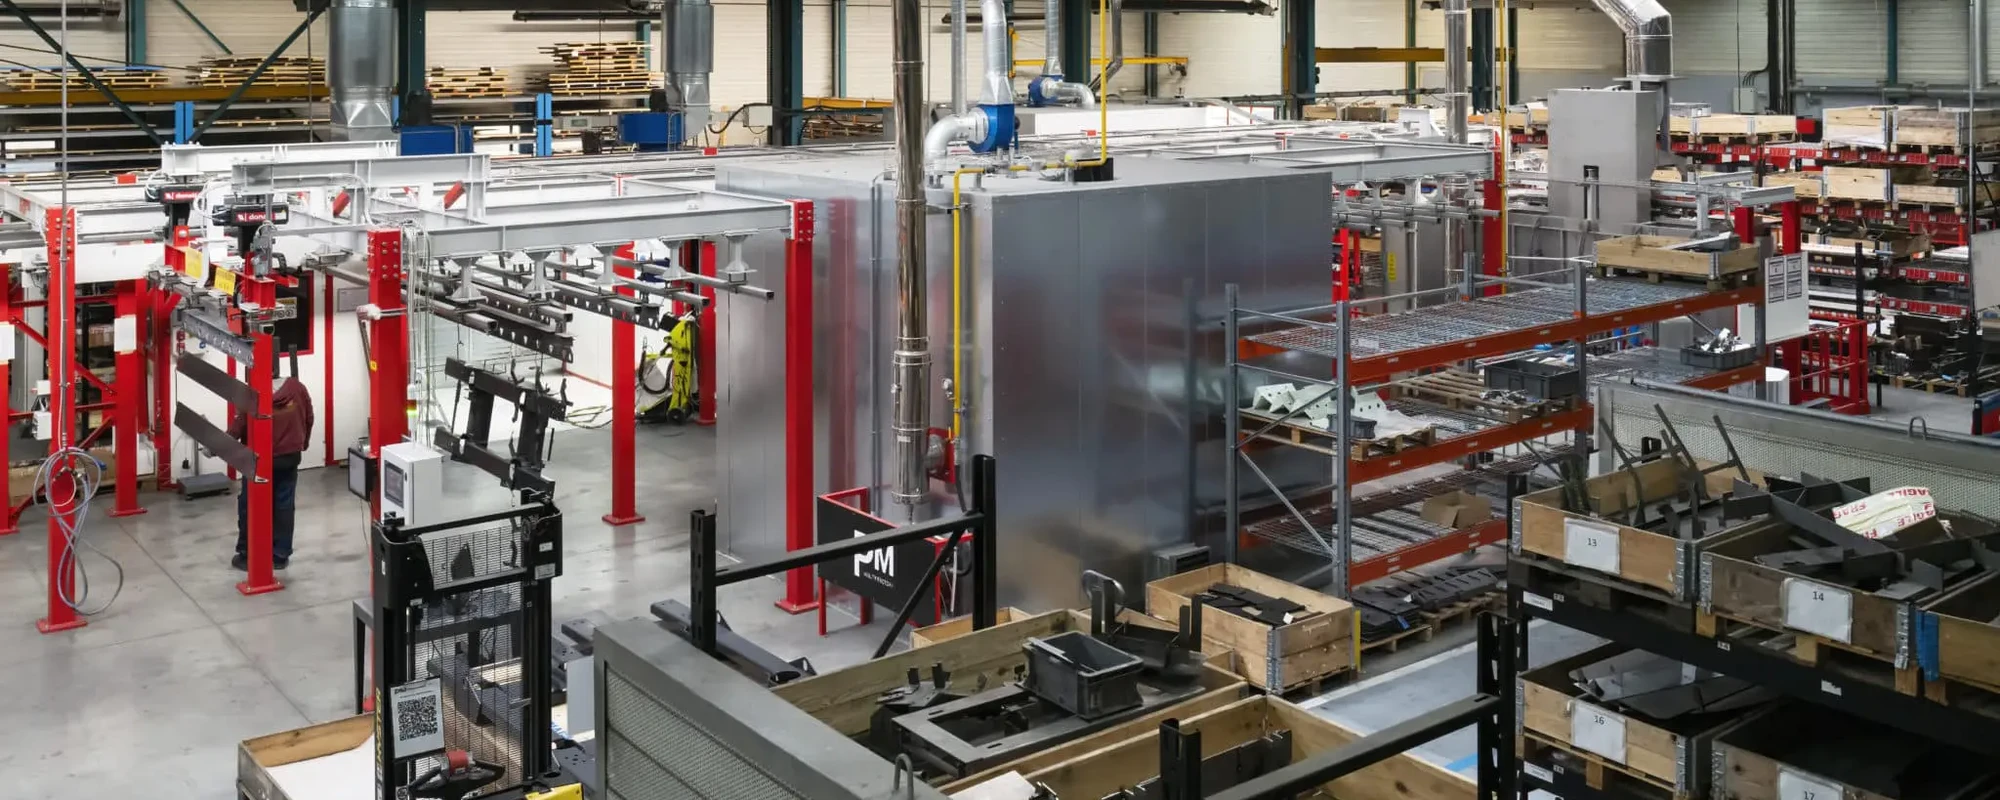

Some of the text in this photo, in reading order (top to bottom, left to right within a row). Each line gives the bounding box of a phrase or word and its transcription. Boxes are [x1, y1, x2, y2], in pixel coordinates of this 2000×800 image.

[1588, 538, 1597, 547] 13
[1812, 591, 1824, 602] 14
[1594, 715, 1605, 726] 16
[1804, 790, 1815, 800] 17
